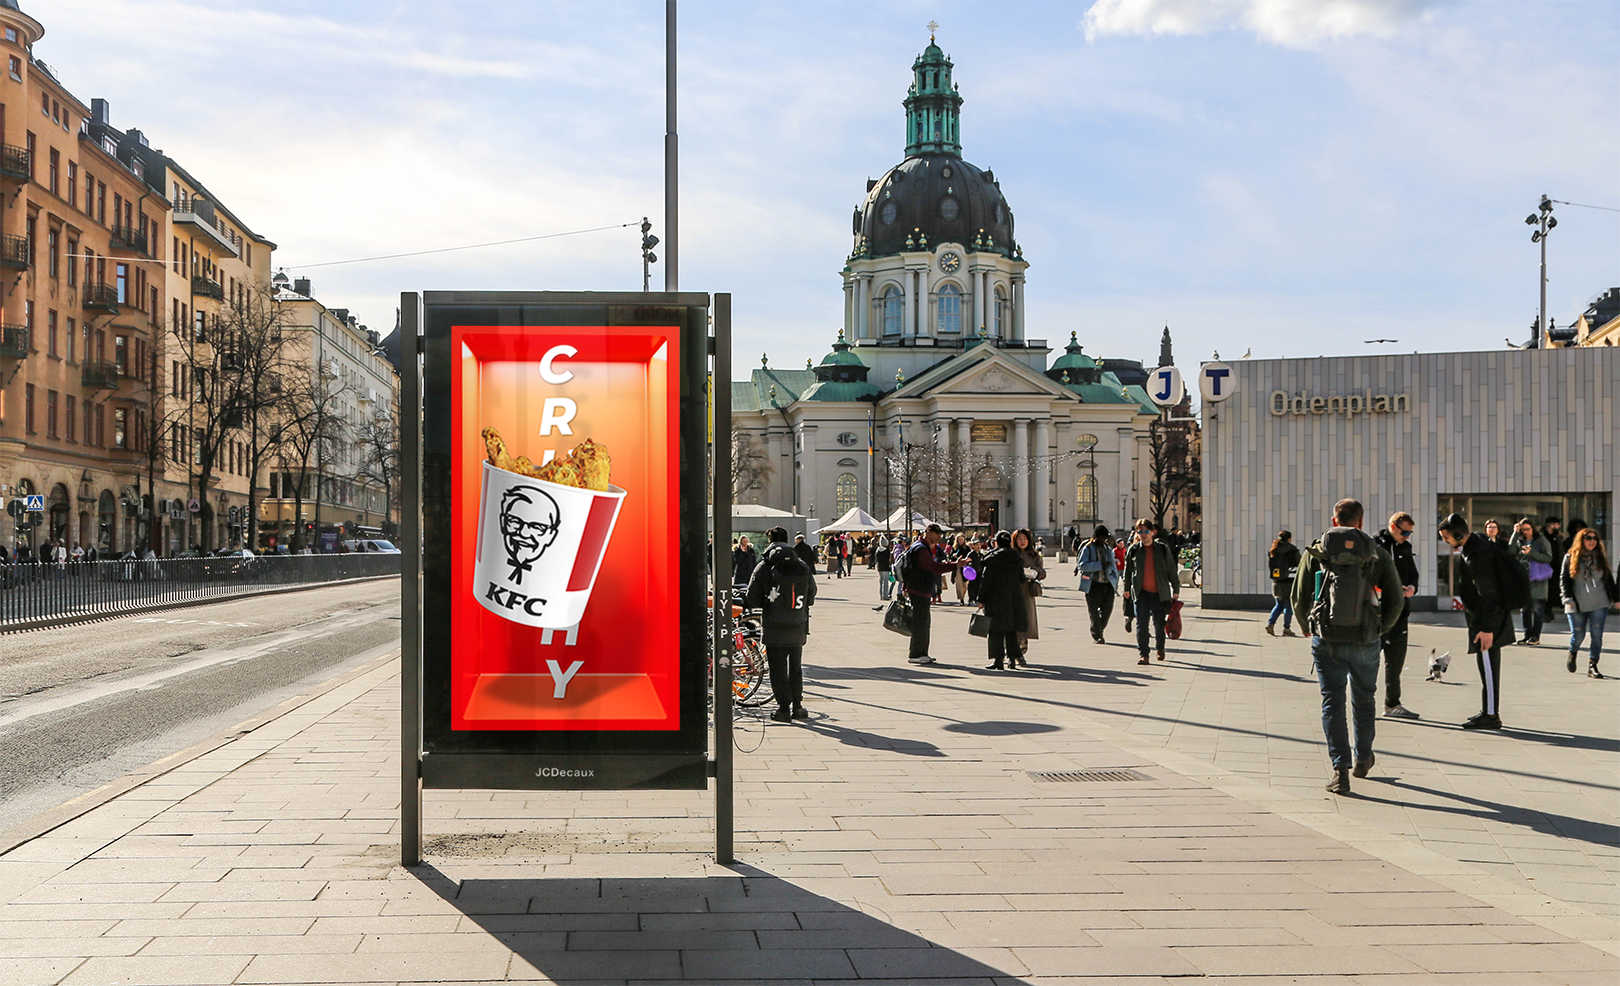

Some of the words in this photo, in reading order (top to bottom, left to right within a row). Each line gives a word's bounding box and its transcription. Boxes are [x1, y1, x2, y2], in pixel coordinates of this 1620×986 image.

[1155, 371, 1172, 400] J
[1205, 368, 1229, 396] T
[1269, 387, 1410, 419] Odenplan
[485, 581, 548, 617] KFC
[535, 767, 595, 777] JCDecaux
